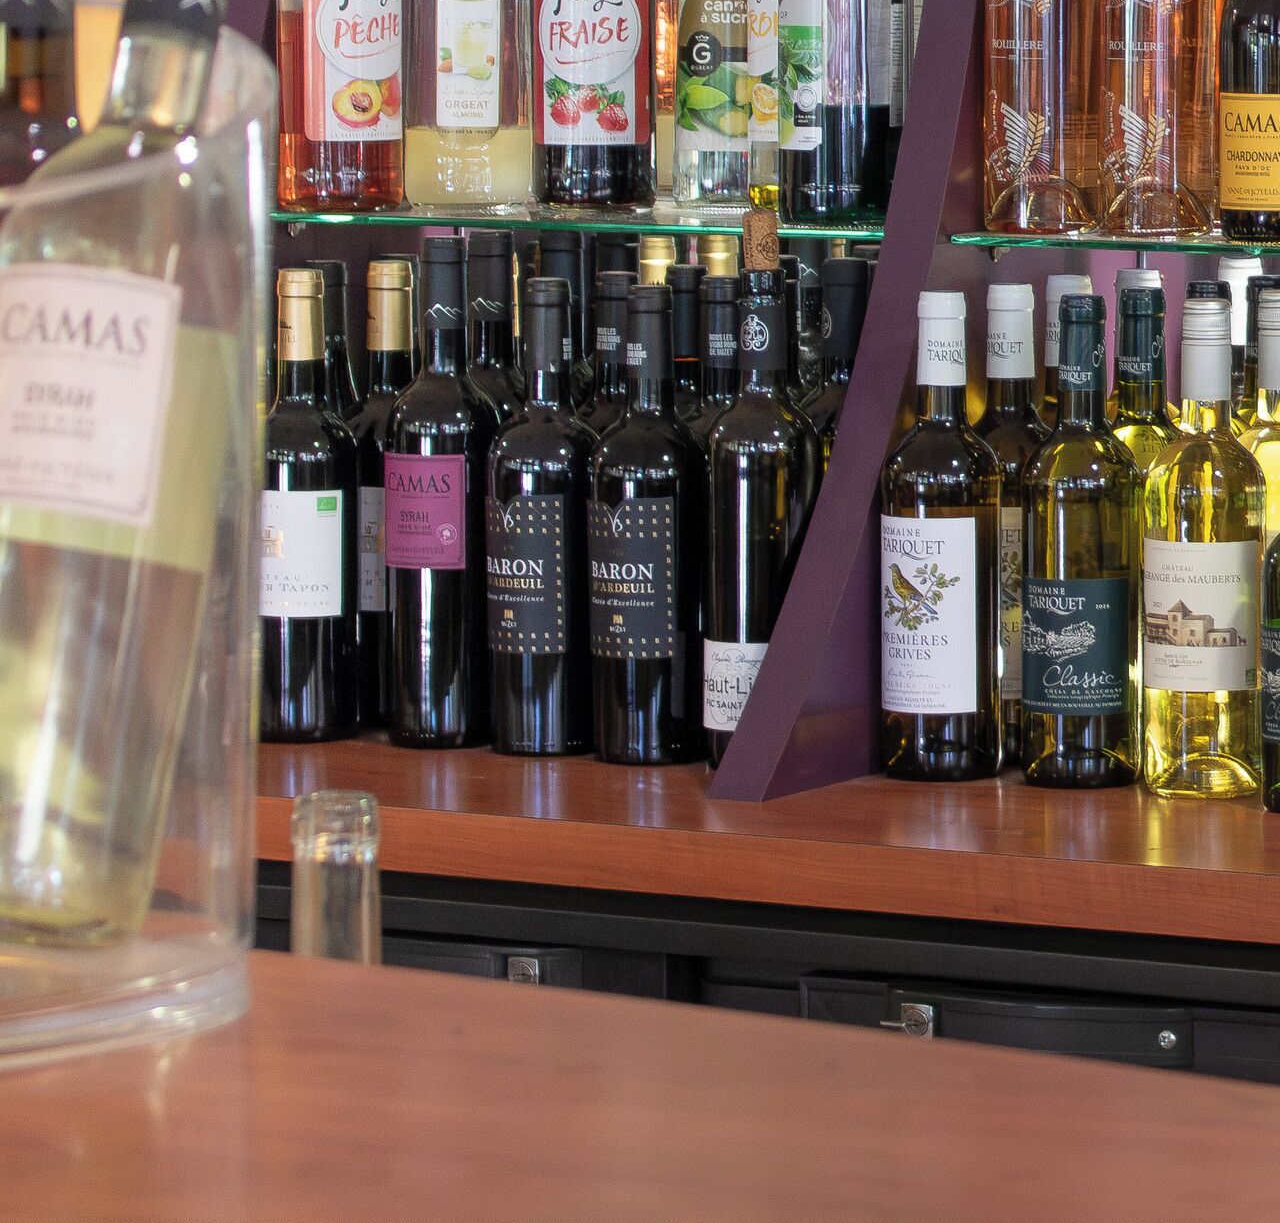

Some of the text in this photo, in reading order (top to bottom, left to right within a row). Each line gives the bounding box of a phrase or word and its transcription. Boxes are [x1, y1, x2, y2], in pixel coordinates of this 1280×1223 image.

[711, 11, 748, 24] sucr
[549, 16, 630, 52] FRAISE
[692, 42, 712, 64] G
[445, 99, 490, 110] ORGEAT
[2, 302, 151, 355] CAMAS
[387, 473, 451, 494] CAMAS
[882, 526, 921, 538] DOMAINE
[882, 537, 946, 561] TARIQUET
[487, 556, 544, 576] BARON
[592, 560, 654, 580] BARON
[1161, 562, 1194, 572] CHÂTEAU
[1187, 574, 1241, 585] MAUBERTS
[1028, 584, 1066, 596] DOMAINE
[607, 597, 655, 607] d'Excellence
[1028, 595, 1086, 616] TARIQUET
[883, 632, 949, 646] PREMIÈRES
[888, 647, 931, 661] GRIVES
[704, 674, 754, 695] Haut-Li
[1042, 664, 1122, 689] Classic
[716, 700, 743, 710] SAINT
